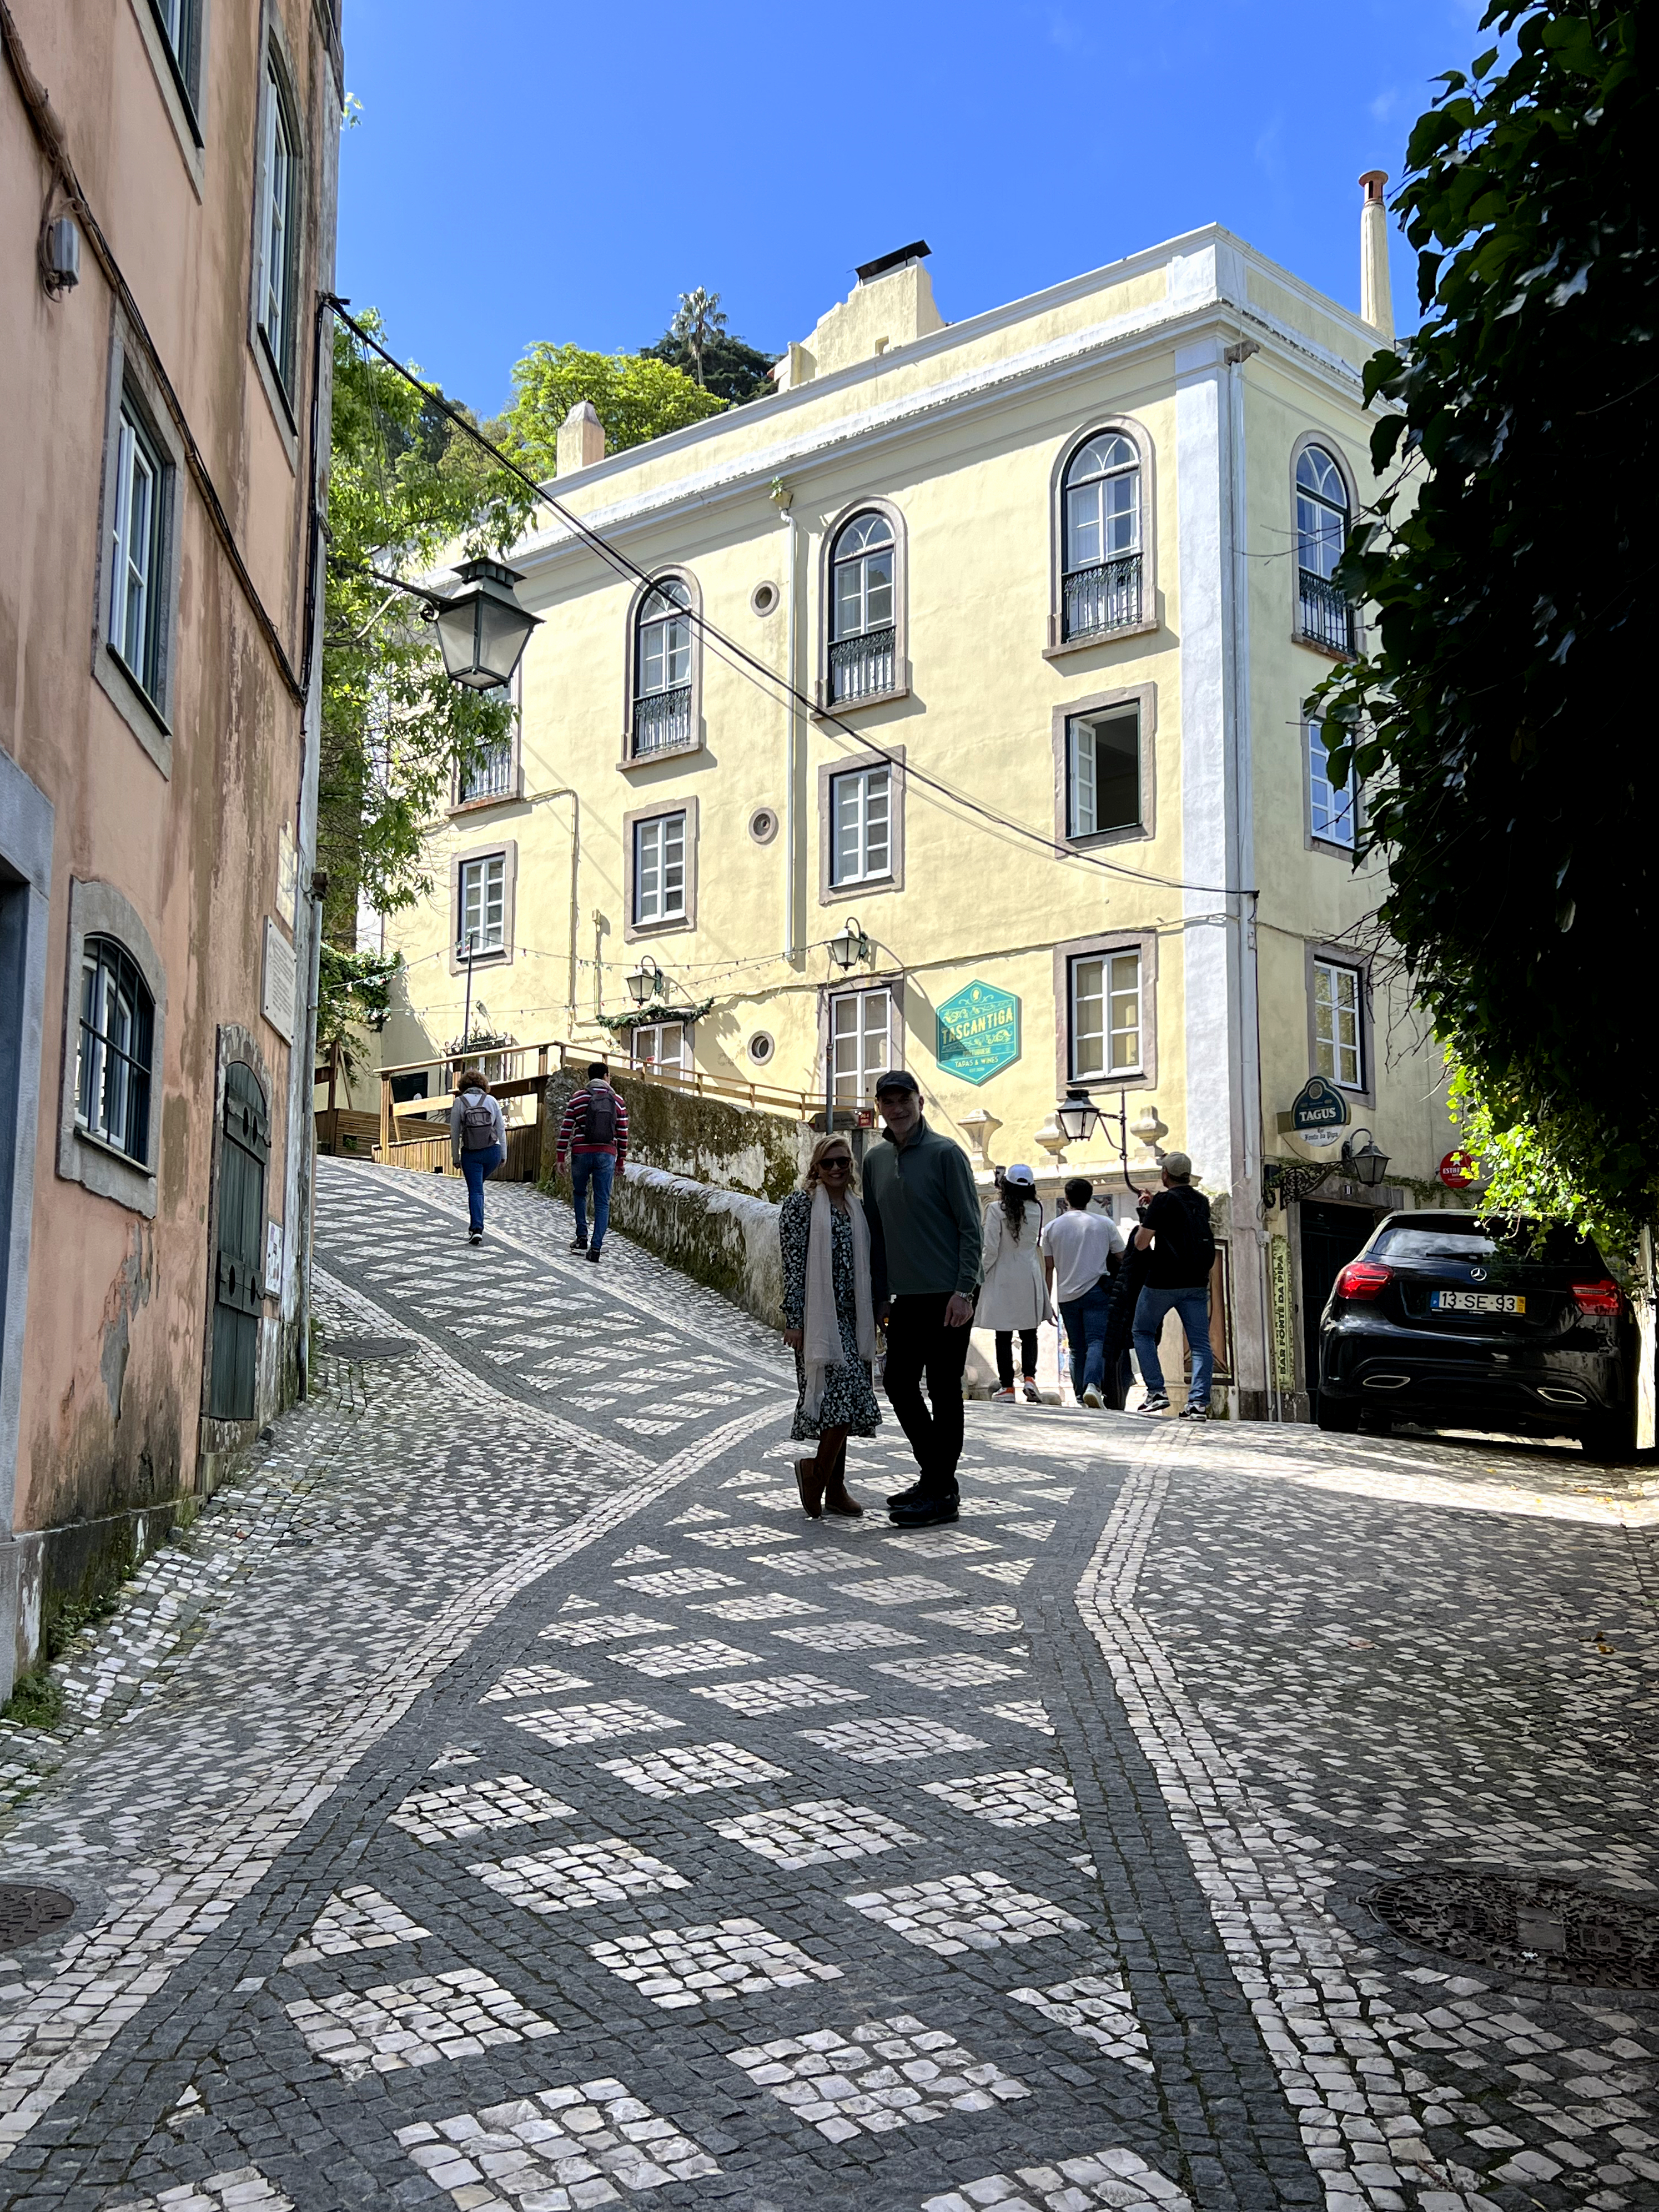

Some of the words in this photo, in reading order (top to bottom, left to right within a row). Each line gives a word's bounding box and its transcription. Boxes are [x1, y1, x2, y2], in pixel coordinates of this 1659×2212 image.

[941, 1007, 1013, 1045] TASCANTIGA
[981, 1056, 998, 1064] WINES
[1299, 1107, 1336, 1122] TAGUS
[1278, 1286, 1284, 1303] DA
